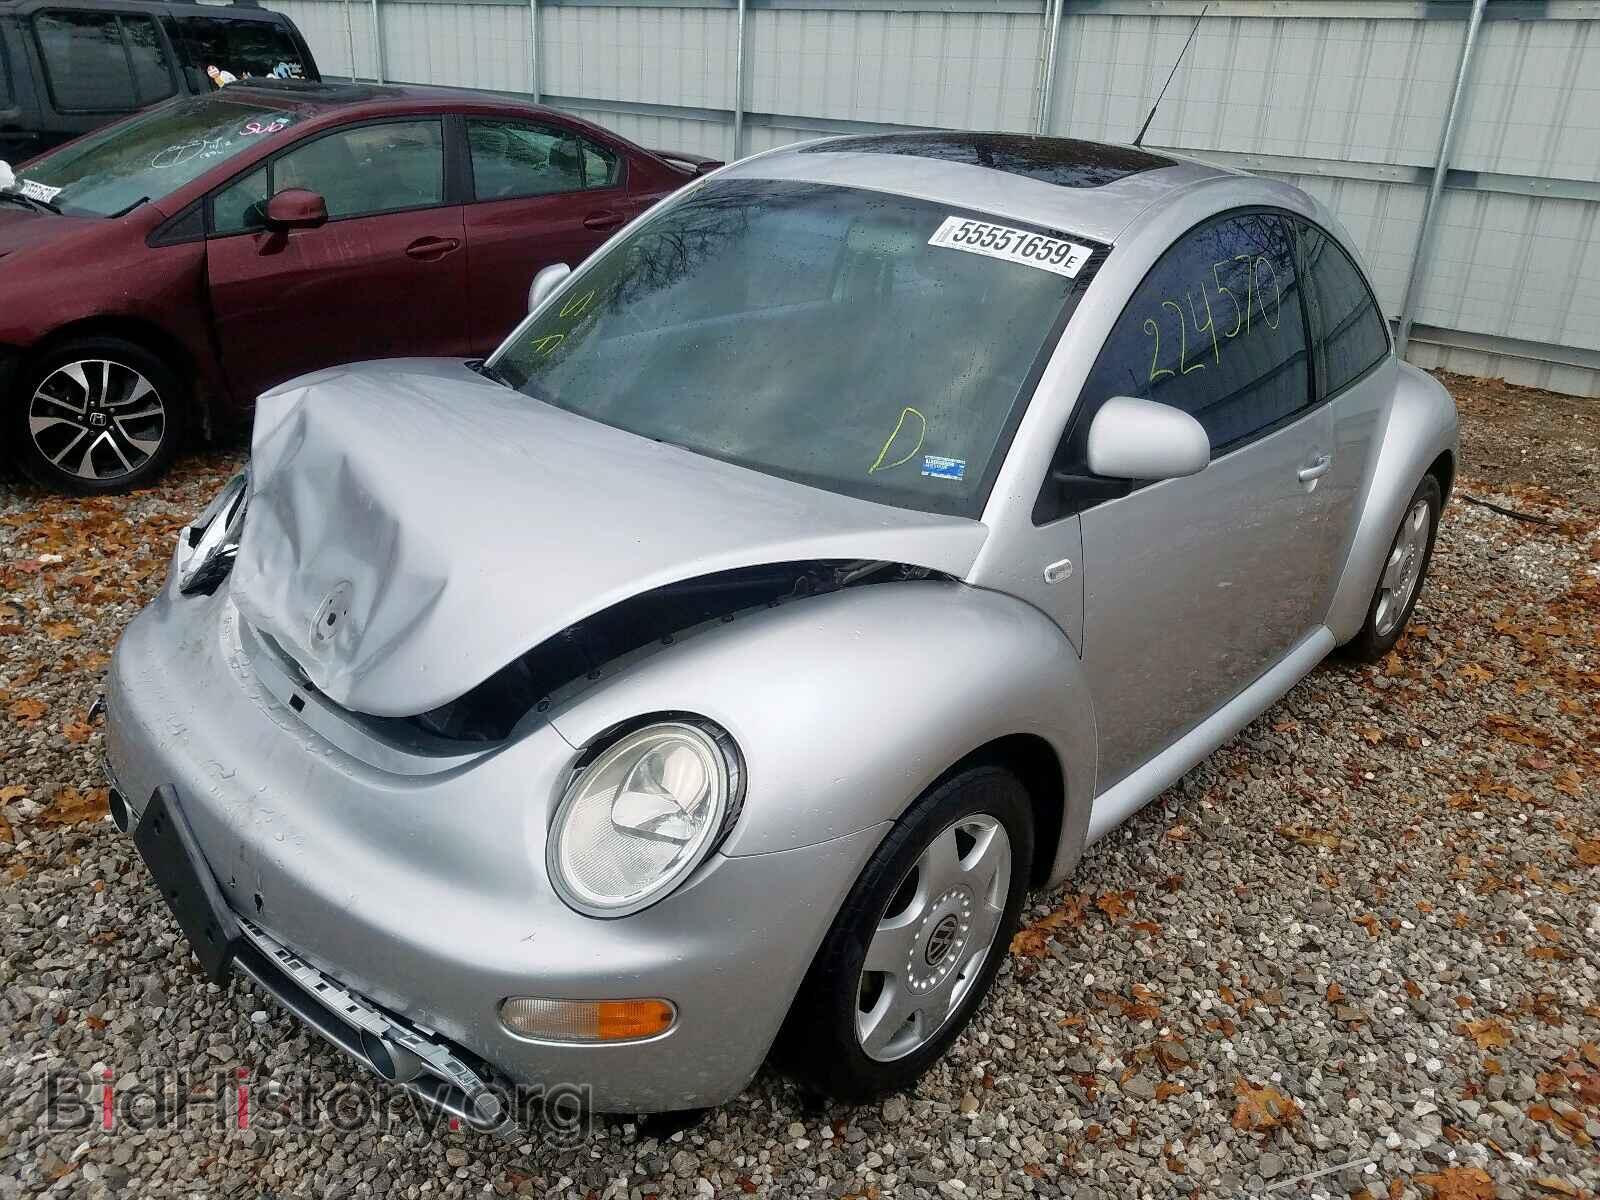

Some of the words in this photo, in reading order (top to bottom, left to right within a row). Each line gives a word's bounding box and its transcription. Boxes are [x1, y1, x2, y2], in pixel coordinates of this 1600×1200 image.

[952, 221, 1073, 265] 55551659
[1064, 255, 1078, 268] E
[1143, 254, 1280, 382] 224570
